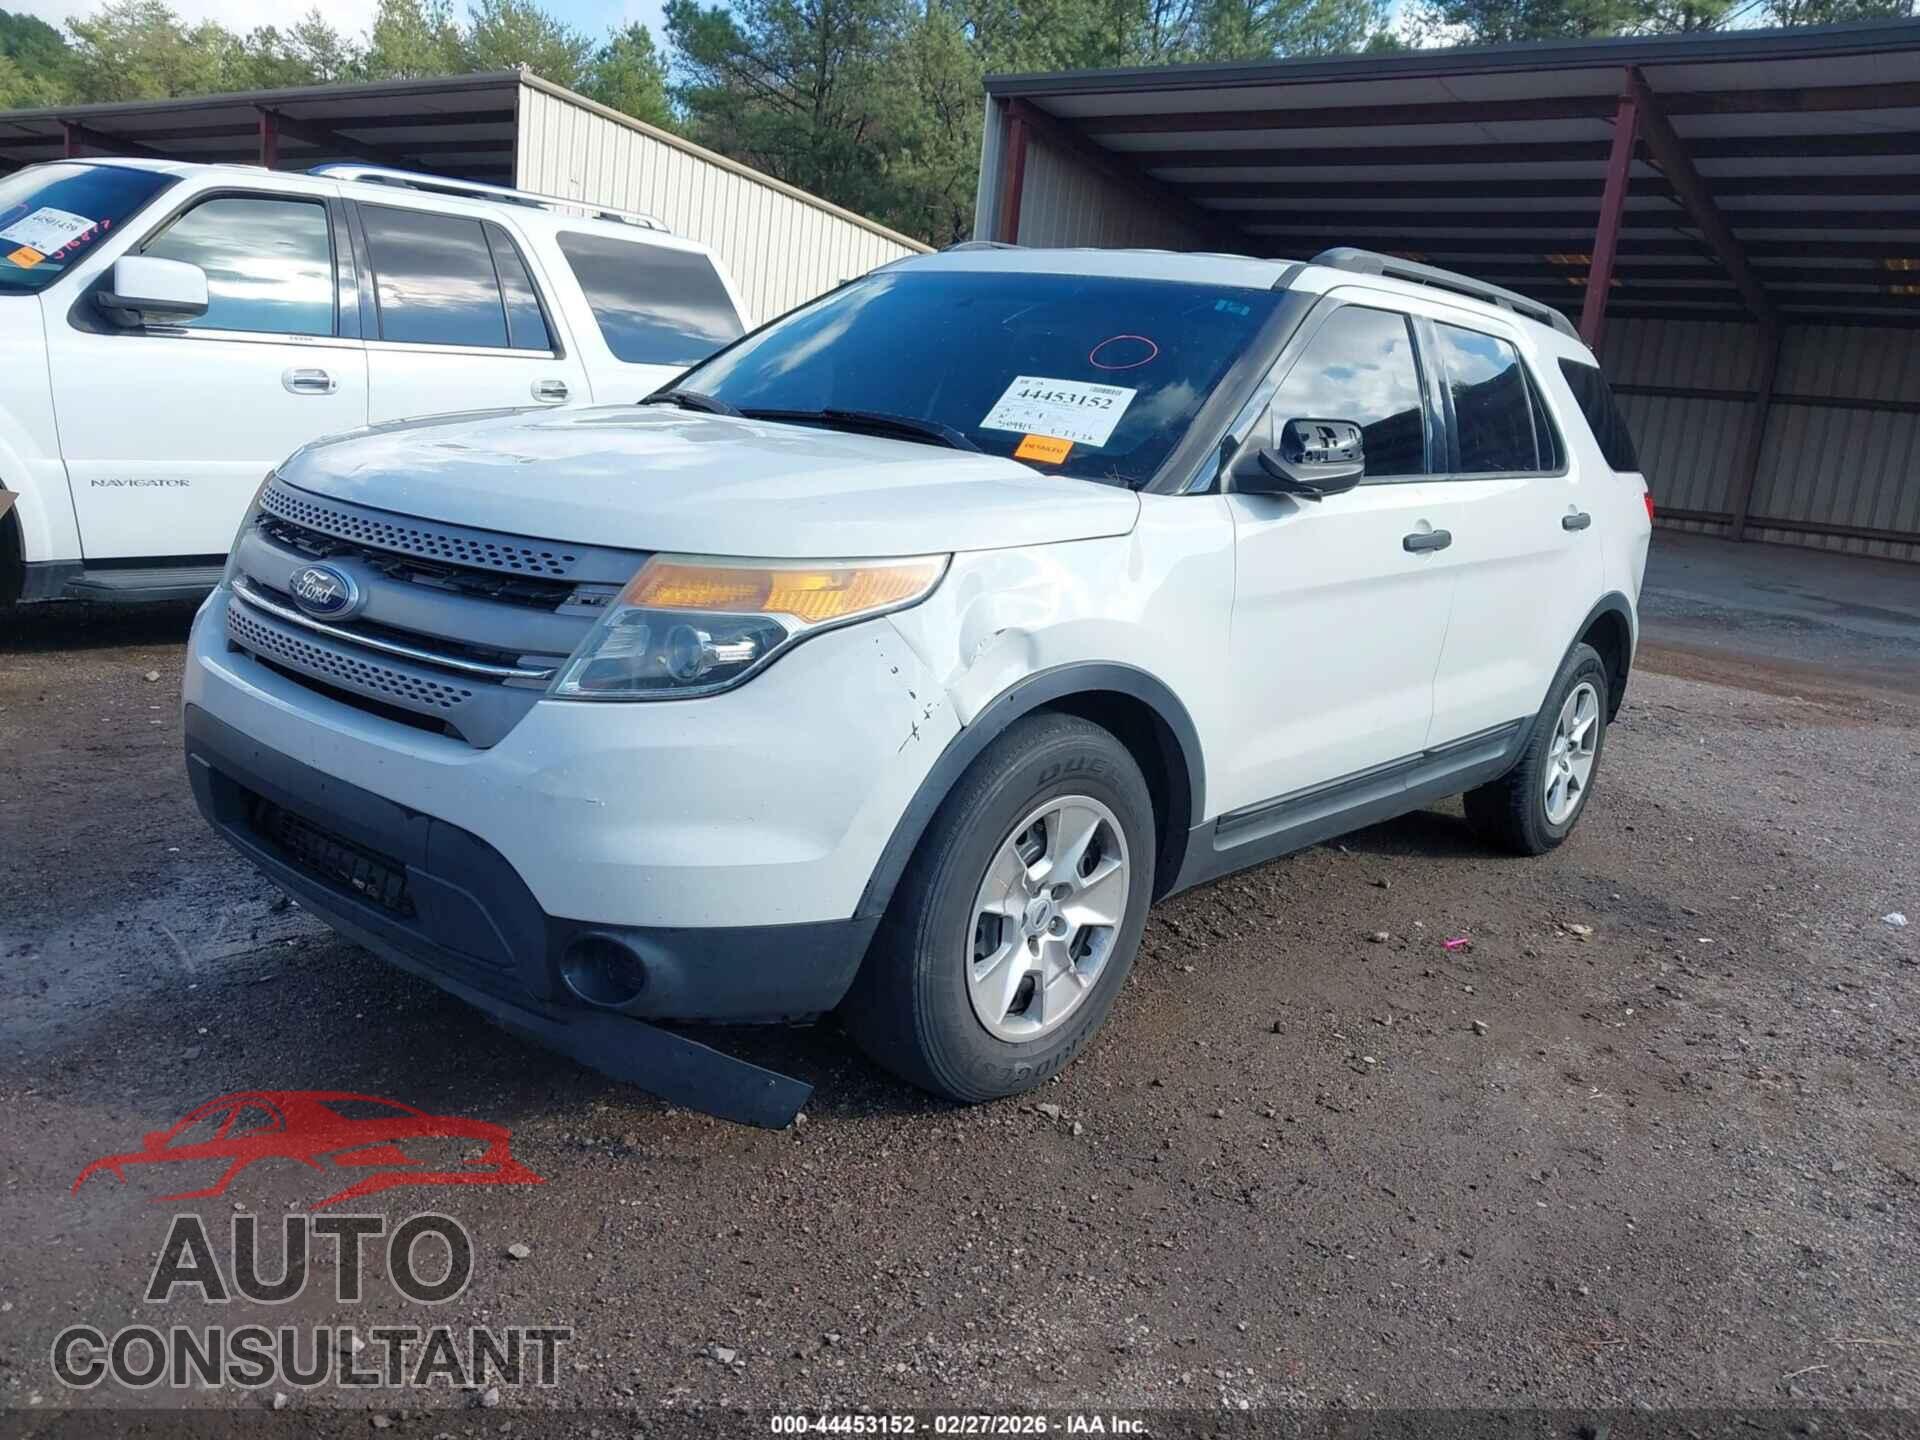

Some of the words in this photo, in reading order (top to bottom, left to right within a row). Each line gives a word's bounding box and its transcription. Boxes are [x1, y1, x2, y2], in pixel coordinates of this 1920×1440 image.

[1016, 388, 1113, 410] 44453152
[91, 479, 190, 487] NAVIGATOR
[296, 569, 336, 604] Ford
